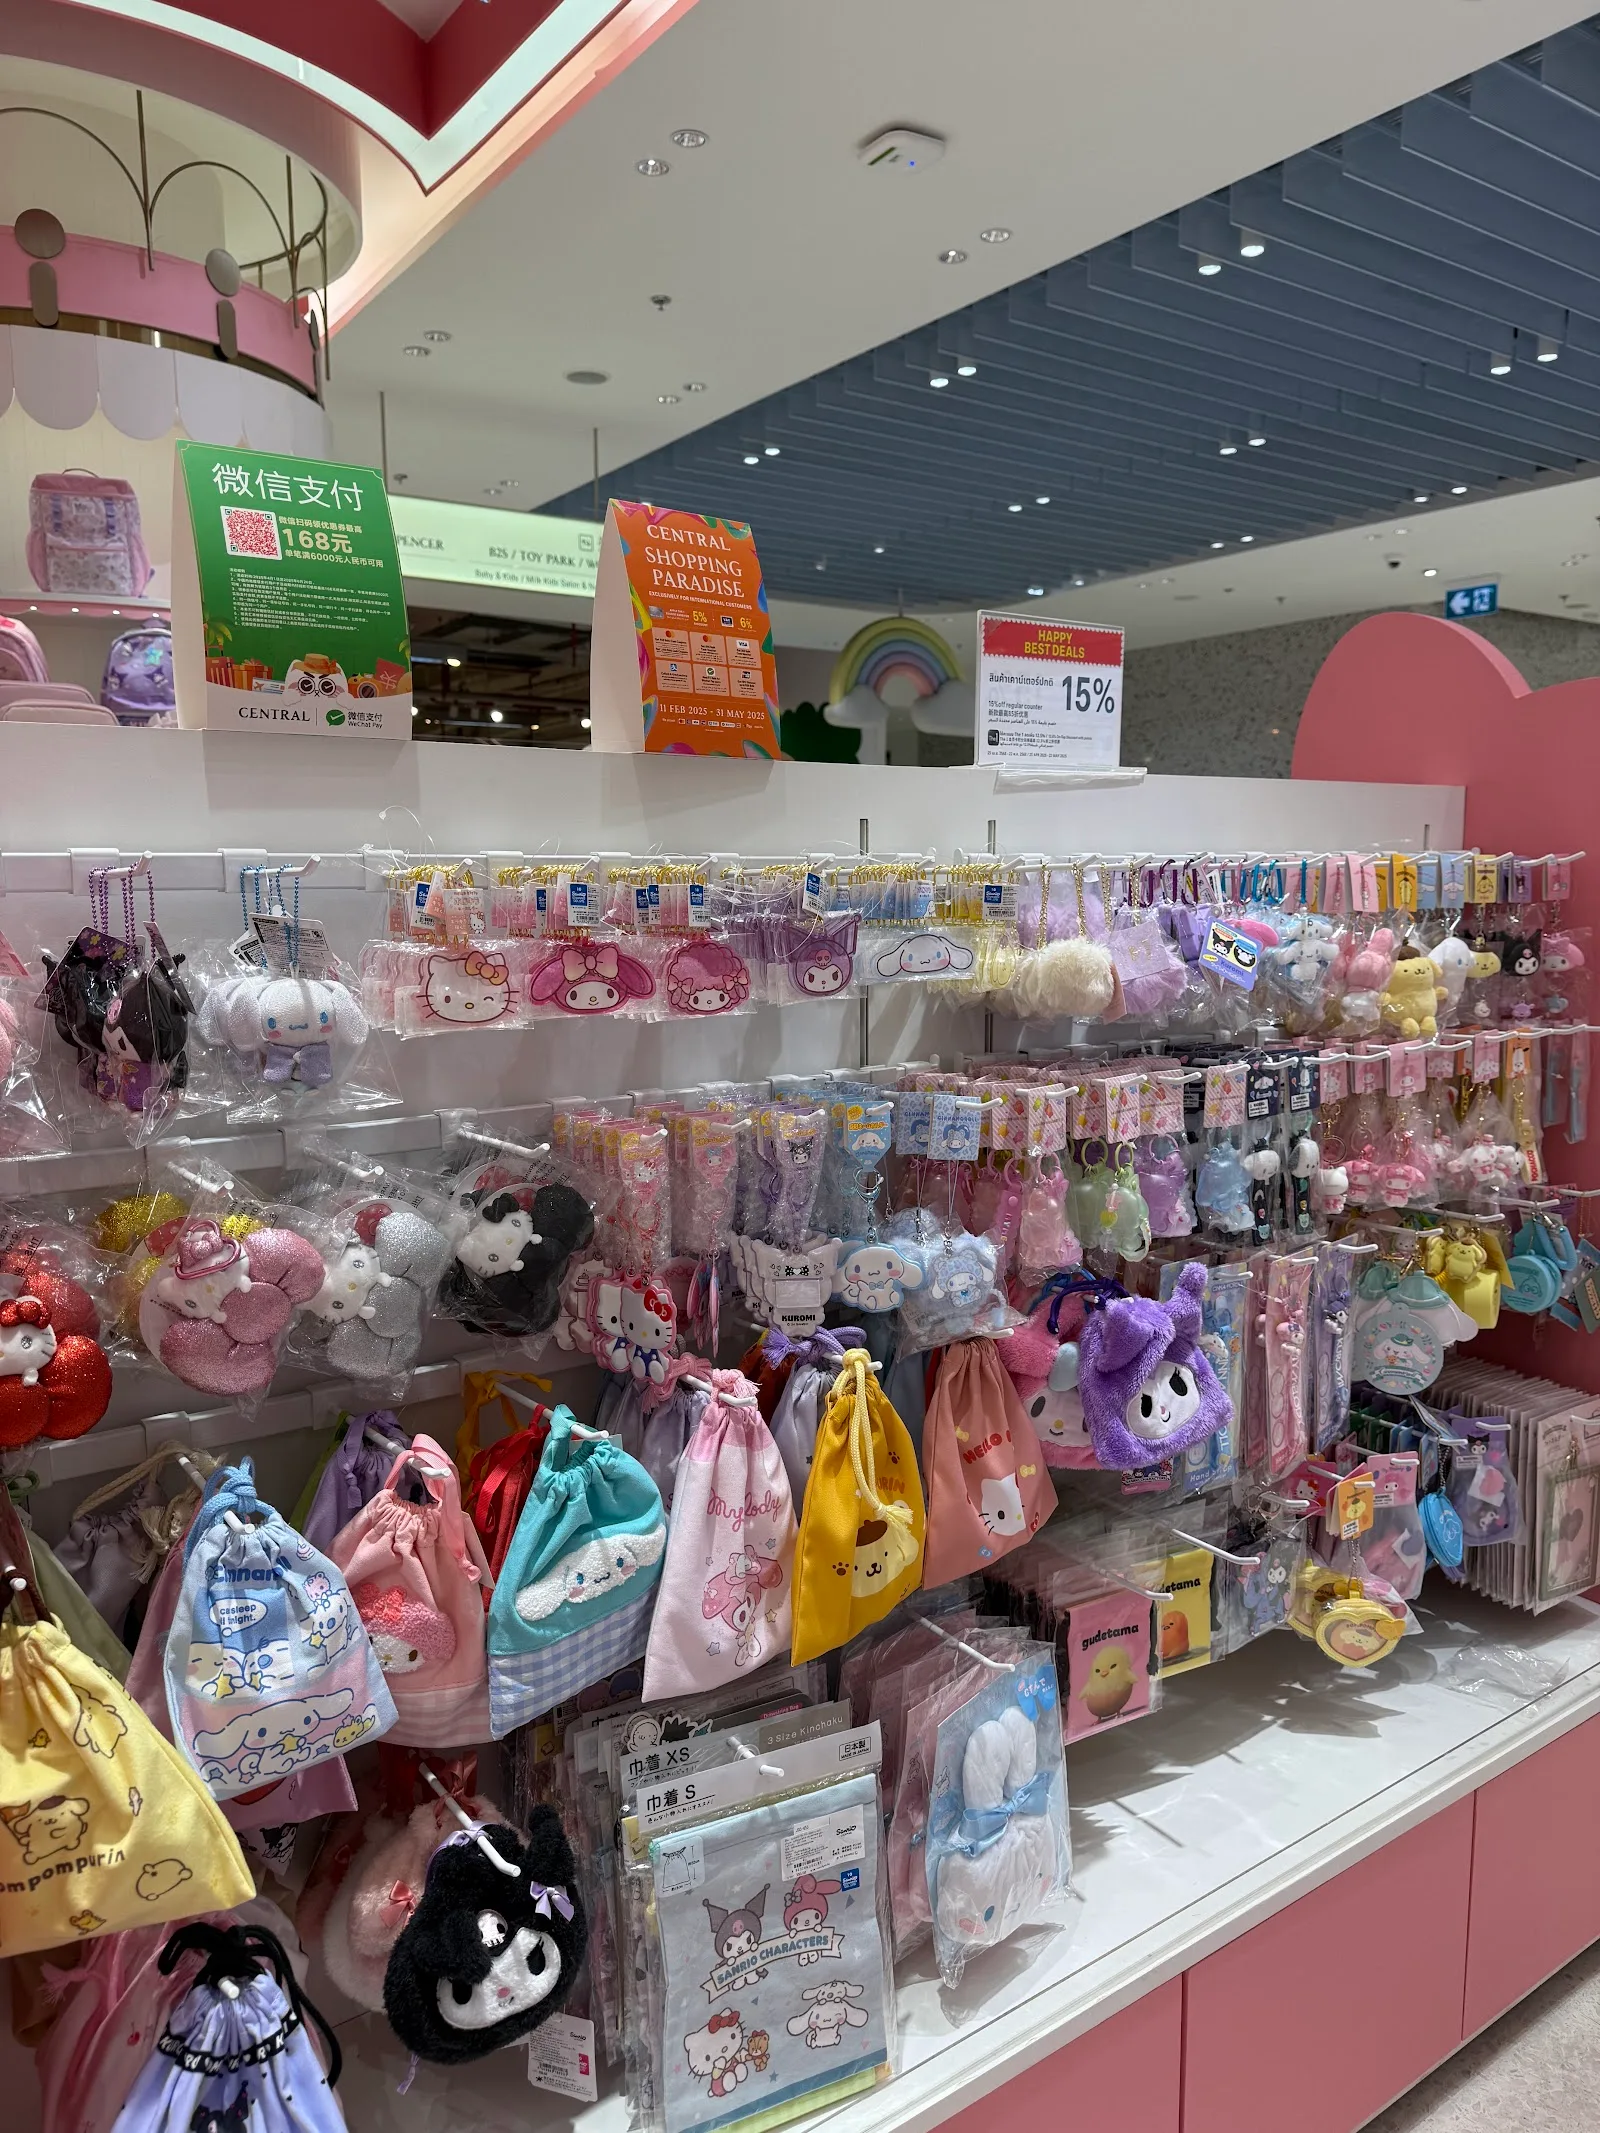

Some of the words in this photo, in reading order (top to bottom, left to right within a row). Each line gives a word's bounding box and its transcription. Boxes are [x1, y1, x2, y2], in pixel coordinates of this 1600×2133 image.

[212, 462, 363, 512] 微信支付
[282, 529, 352, 554] 168元
[396, 534, 444, 550] PENCER
[646, 525, 731, 551] CENTRAL
[284, 549, 384, 568] 单笔满6000元人民币可用
[520, 550, 542, 563] TOY
[545, 553, 576, 566] PARK
[645, 546, 743, 577] SHOPPING
[502, 572, 518, 582] Kids
[544, 577, 559, 587] Kids
[653, 569, 745, 598] PARADISE
[648, 590, 680, 601] EXCLUSIVELY
[680, 594, 690, 602] FOR
[690, 595, 725, 607] INTERNATIONAL
[725, 601, 753, 610] CUSTOMERS
[692, 610, 708, 623] 5%
[1038, 629, 1073, 644] HAPPY
[1024, 642, 1051, 656] BEST
[1052, 645, 1085, 659] DEALS
[1062, 675, 1115, 714] 15%
[238, 707, 311, 722] CENTRAL
[660, 703, 667, 713] 11
[669, 705, 686, 714] FEB
[688, 706, 708, 716] 2025
[716, 708, 724, 717] 31
[726, 709, 745, 719] MAY
[747, 711, 765, 720] 2025
[1005, 702, 1023, 710] regular
[1024, 703, 1043, 711] counter
[347, 711, 383, 723] 微信支付
[348, 720, 370, 728] WeChat
[371, 722, 383, 730] Pay
[1221, 960, 1244, 976] Kuromi
[1526, 1150, 1539, 1181] POCHACCO
[781, 1314, 816, 1322] KUROMI
[1335, 1338, 1345, 1388] KUROMI
[1190, 1469, 1210, 1482] Hand
[875, 1476, 905, 1494] URIN
[707, 1486, 745, 1532] My
[744, 1489, 781, 1522] lody
[1160, 1577, 1201, 1594] detama
[1082, 1624, 1139, 1651] gudetama
[763, 1707, 789, 1719] Drawstring
[789, 1704, 799, 1712] Bag
[767, 1736, 773, 1745] 3
[775, 1730, 797, 1743] Size
[800, 1716, 843, 1736] Kinchaku
[841, 1751, 852, 1759] MADE
[857, 1747, 869, 1755] JAPAN
[844, 1739, 866, 1753] 日本製
[629, 1753, 661, 1776] 巾着
[666, 1747, 690, 1766] XS
[646, 1788, 679, 1812] 巾着
[685, 1784, 696, 1800] S
[836, 1825, 857, 1836] Sanrio
[716, 1955, 758, 1985] SANRIO
[759, 1935, 829, 1961] CHARACTERS
[569, 2031, 587, 2041] Sanrio
